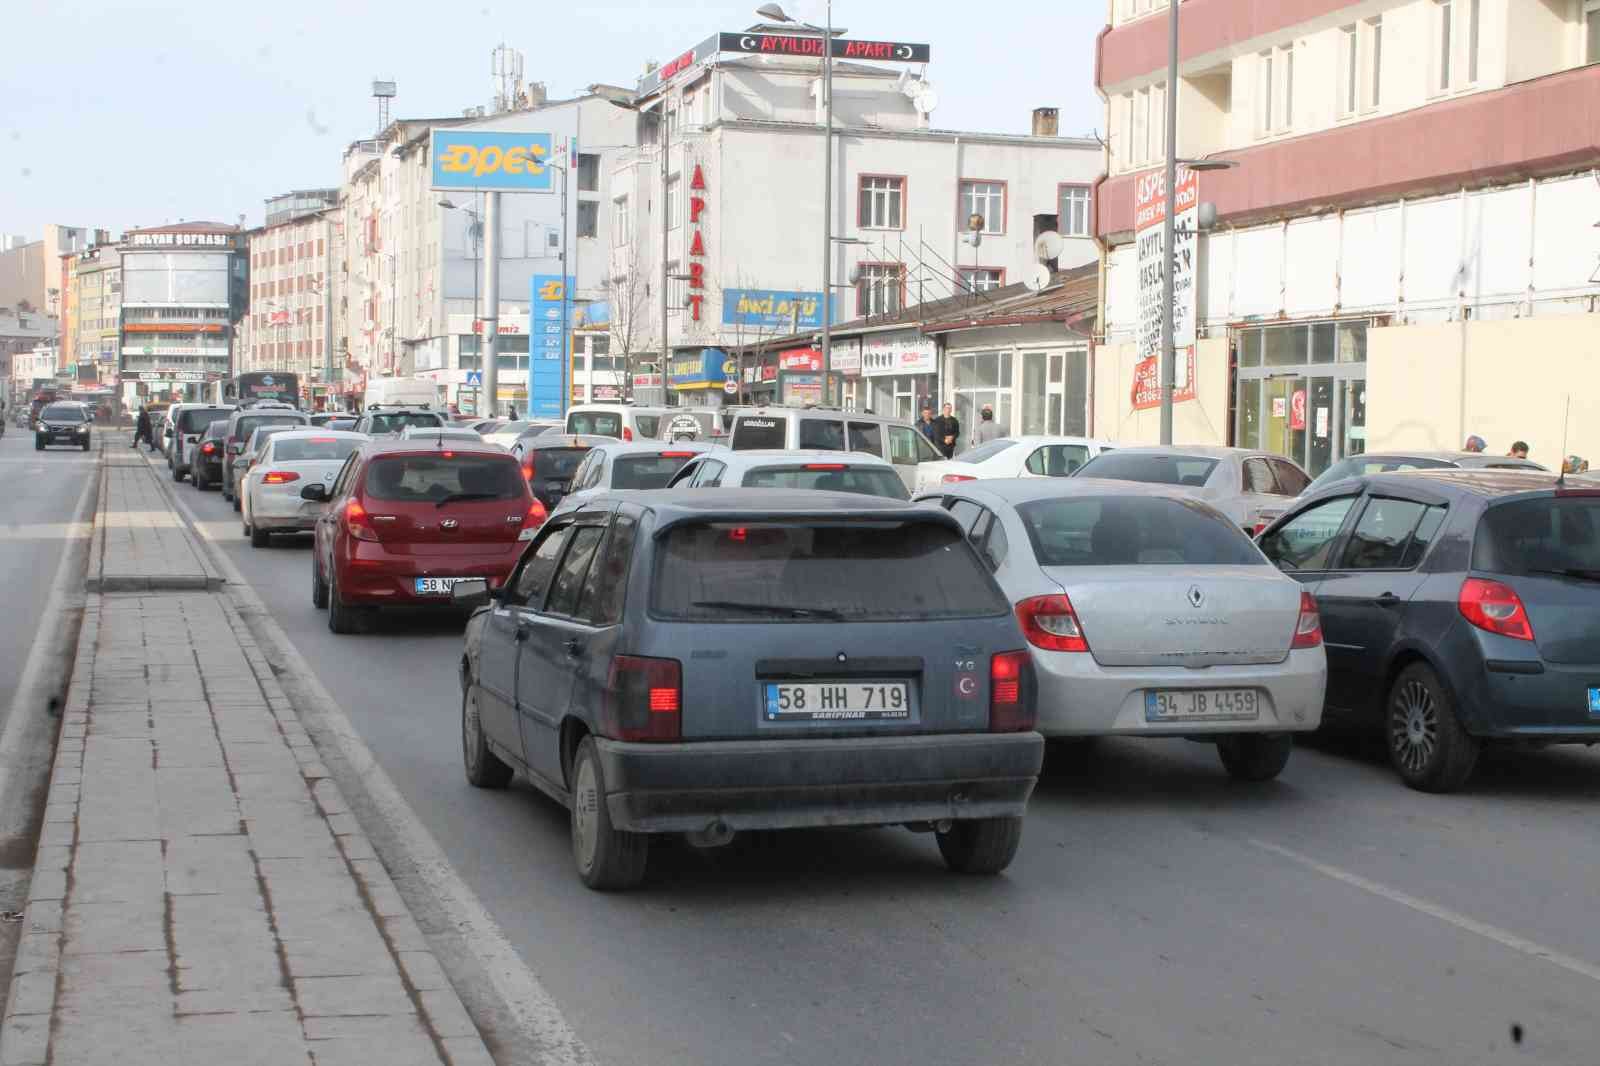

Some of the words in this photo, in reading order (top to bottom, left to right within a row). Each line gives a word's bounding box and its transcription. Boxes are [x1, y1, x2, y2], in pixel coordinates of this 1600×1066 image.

[760, 35, 825, 54] AYYILDIZ
[845, 41, 895, 58] APART
[134, 234, 173, 245] SULTAN
[689, 164, 705, 321] APART
[422, 579, 437, 591] 58
[778, 687, 805, 709] 58
[821, 687, 848, 710] HH
[861, 687, 903, 710] 719
[1158, 694, 1178, 714] 34
[1187, 692, 1208, 713] JB
[1215, 689, 1255, 712] 4459
